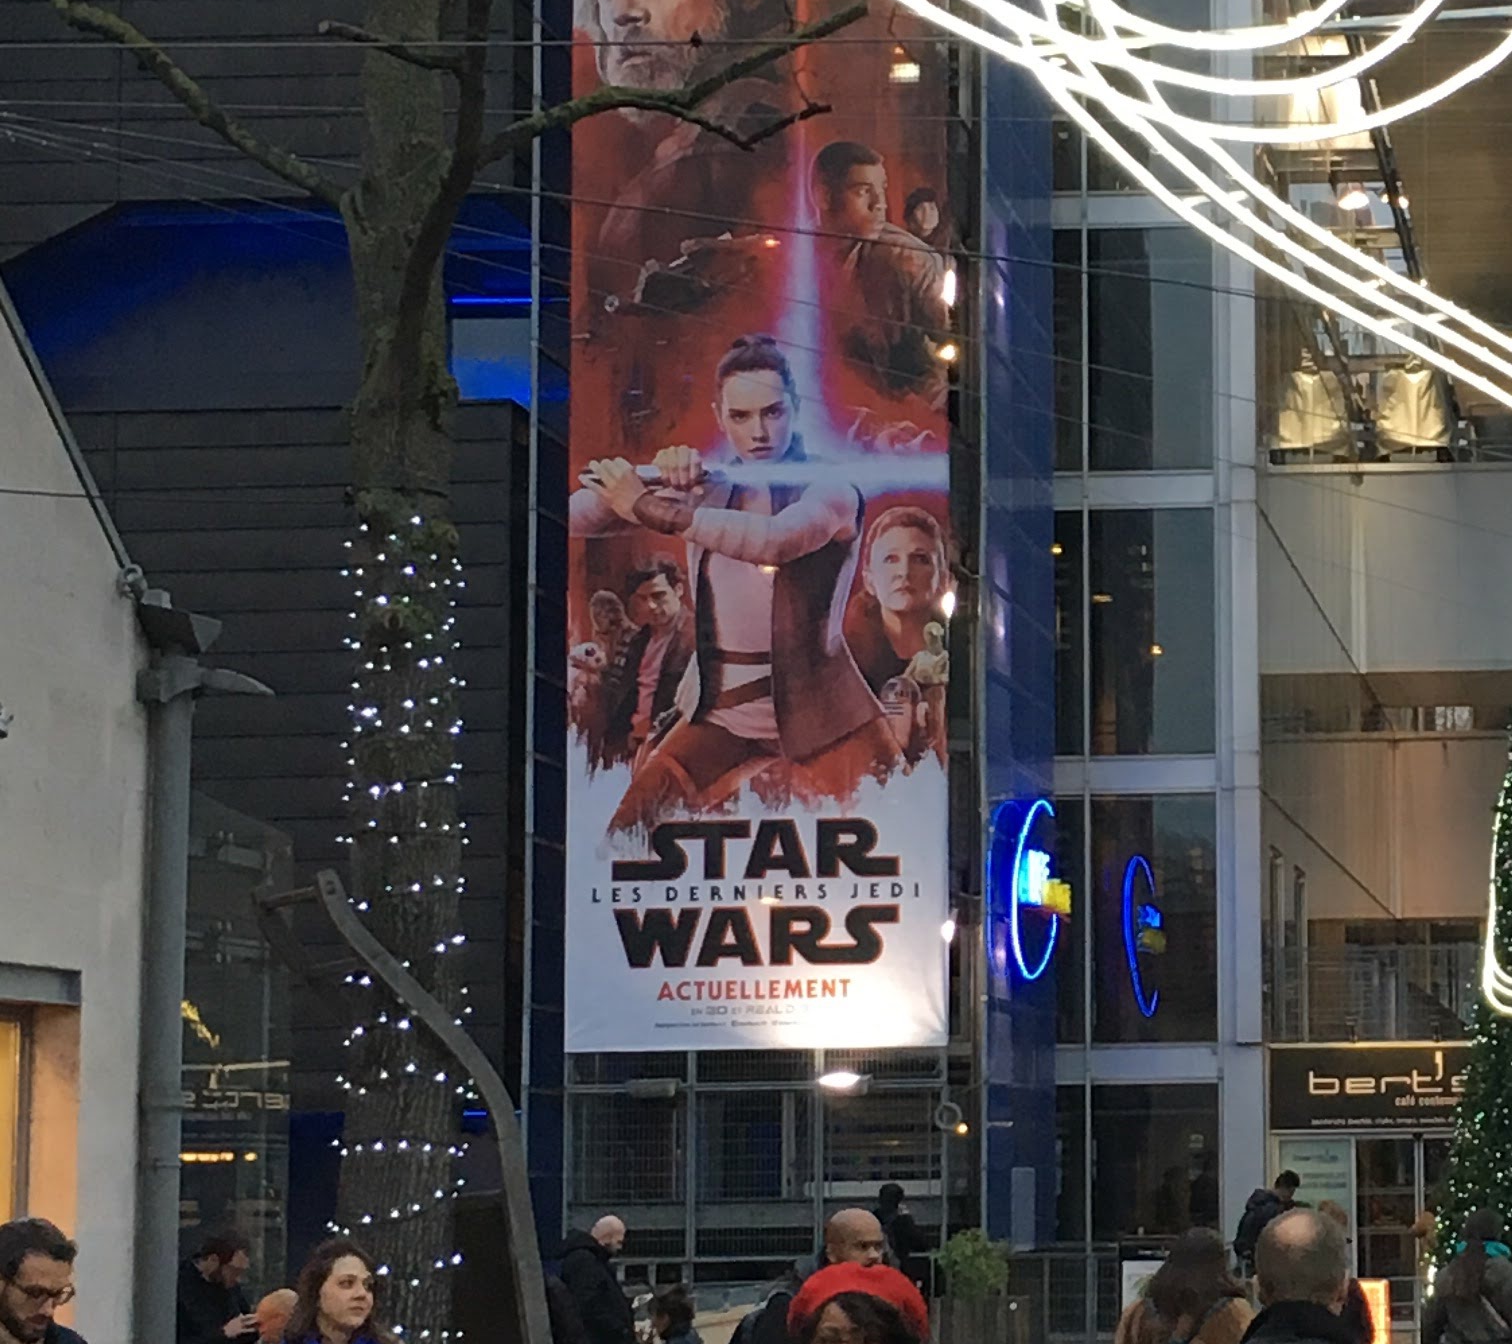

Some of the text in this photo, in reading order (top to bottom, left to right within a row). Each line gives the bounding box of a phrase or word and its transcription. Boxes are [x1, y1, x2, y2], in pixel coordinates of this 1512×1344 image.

[611, 817, 900, 882] STAR
[591, 881, 921, 903] LES DERNIERS JEDI
[612, 903, 901, 969] WARS
[656, 978, 851, 1001] ACTUELLEMENT
